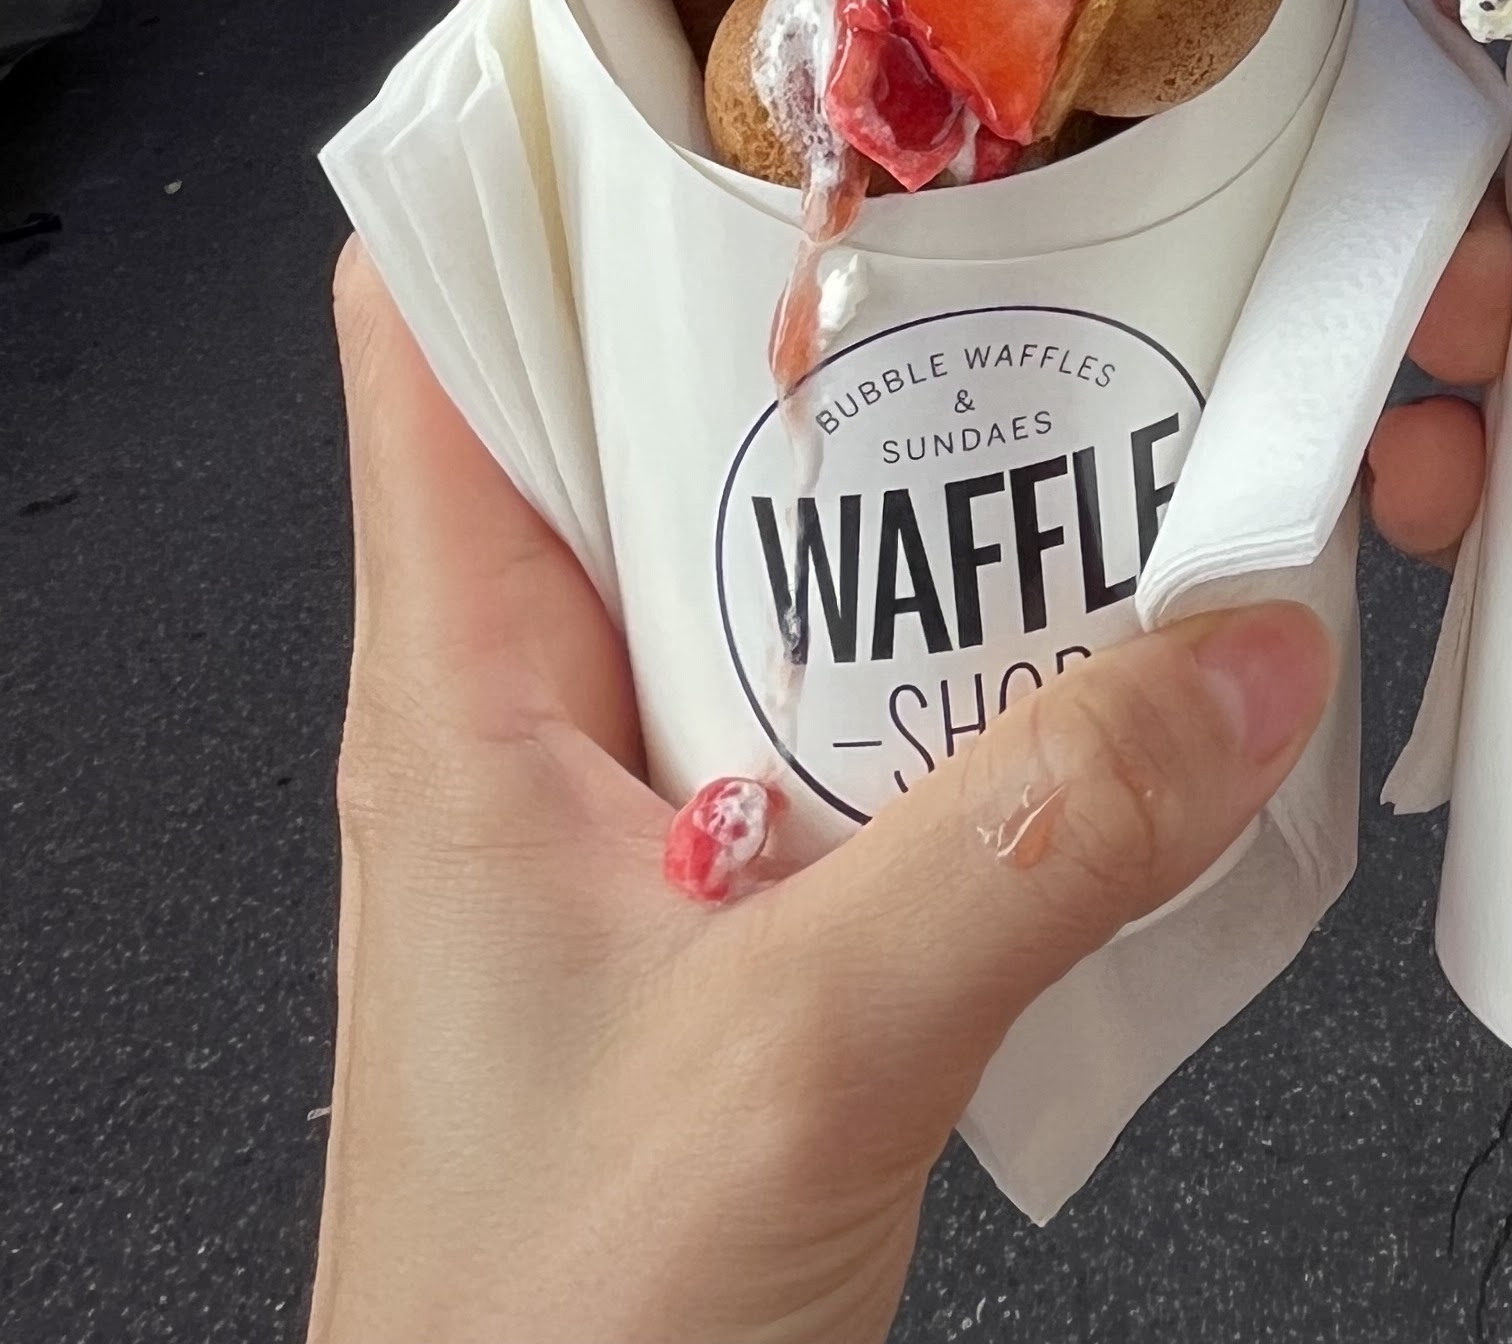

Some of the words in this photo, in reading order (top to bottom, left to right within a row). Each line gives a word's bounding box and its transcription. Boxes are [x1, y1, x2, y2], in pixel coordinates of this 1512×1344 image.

[815, 352, 948, 435] BUBBLE
[964, 344, 1116, 388] WAFFLES
[954, 390, 975, 413] &
[882, 411, 1053, 464] SUNDAES
[888, 645, 1092, 793] SH
